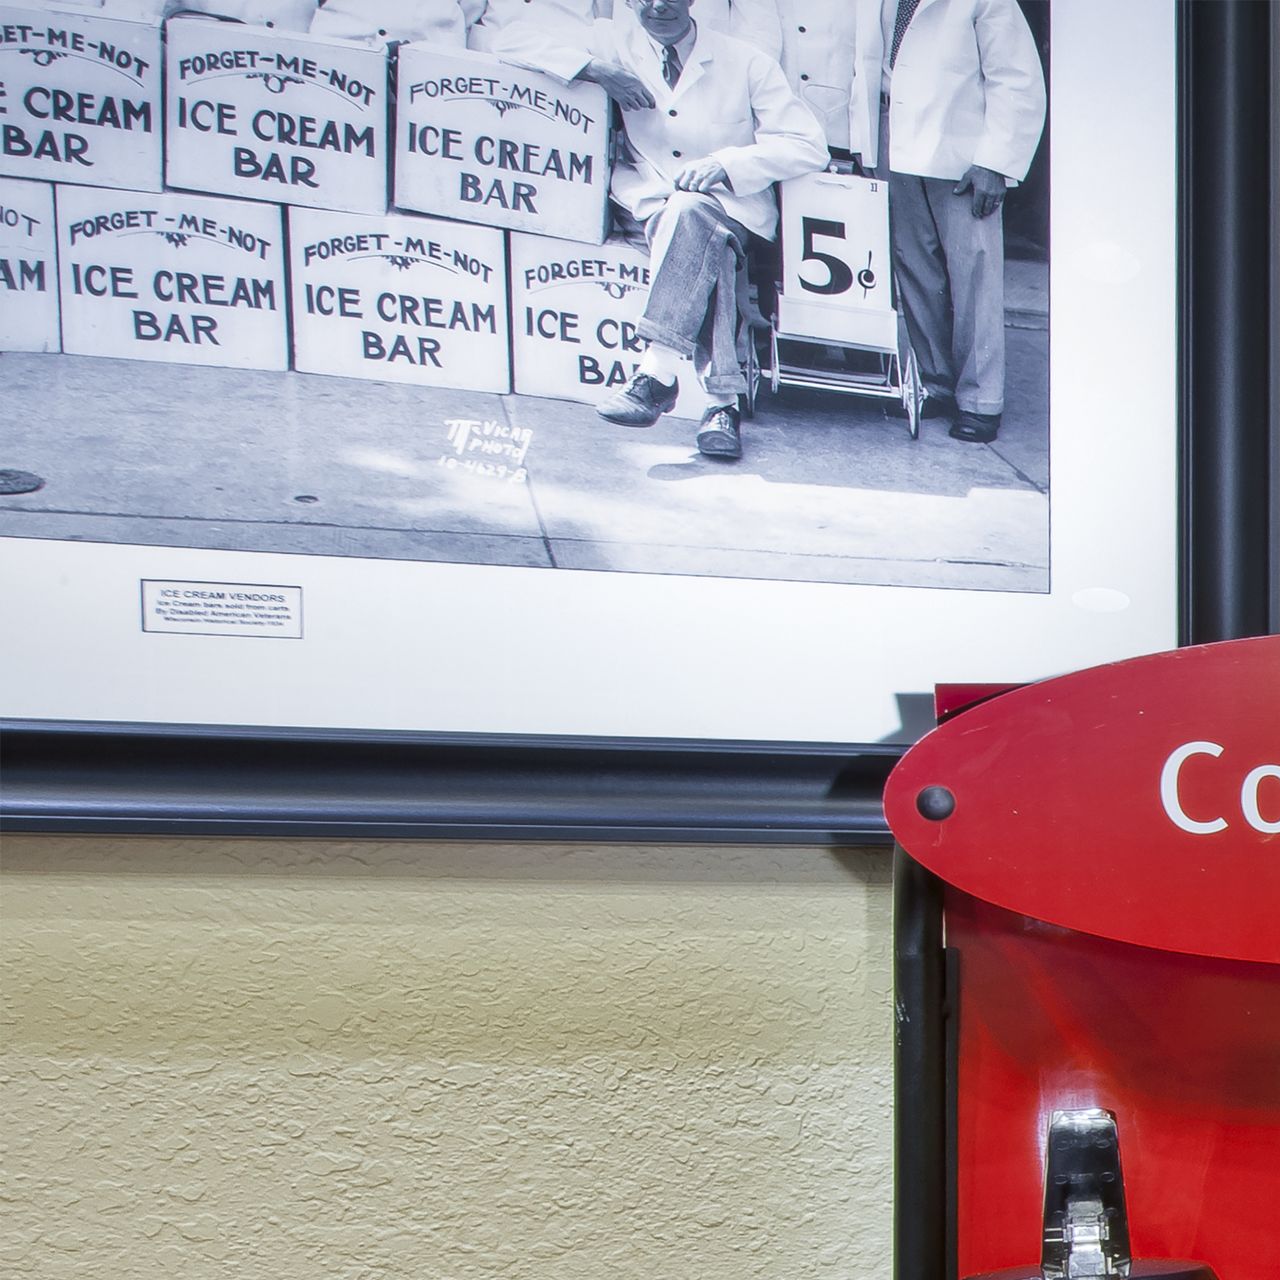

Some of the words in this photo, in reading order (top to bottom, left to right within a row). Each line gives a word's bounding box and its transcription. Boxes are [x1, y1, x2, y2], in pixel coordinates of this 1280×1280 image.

[0, 25, 149, 78] ET-ME-NOT
[179, 51, 376, 107] FORGET-ME-NOT
[23, 86, 152, 133] CREAM
[179, 97, 237, 136] ICE
[252, 109, 376, 158] CREAM
[410, 77, 595, 134] FORGET-ME-NOT
[2, 124, 94, 166] BAR
[233, 148, 320, 188] BAR
[408, 122, 464, 161] ICE
[474, 136, 594, 184] CREAM
[459, 173, 539, 214] BAR
[70, 210, 271, 260] FORGET-ME-NOT
[304, 234, 493, 286] FORGET-ME-NOT
[72, 263, 138, 299] ICE
[153, 270, 276, 311] CREAM
[305, 284, 361, 319] ICE
[376, 291, 496, 334] CREAM
[133, 310, 221, 346] BAR
[526, 306, 581, 344] ICE
[362, 331, 443, 368] BAR
[579, 355, 641, 388] BA
[160, 589, 181, 599] ICE
[183, 590, 225, 600] CREAM
[229, 592, 286, 603] VENDORS
